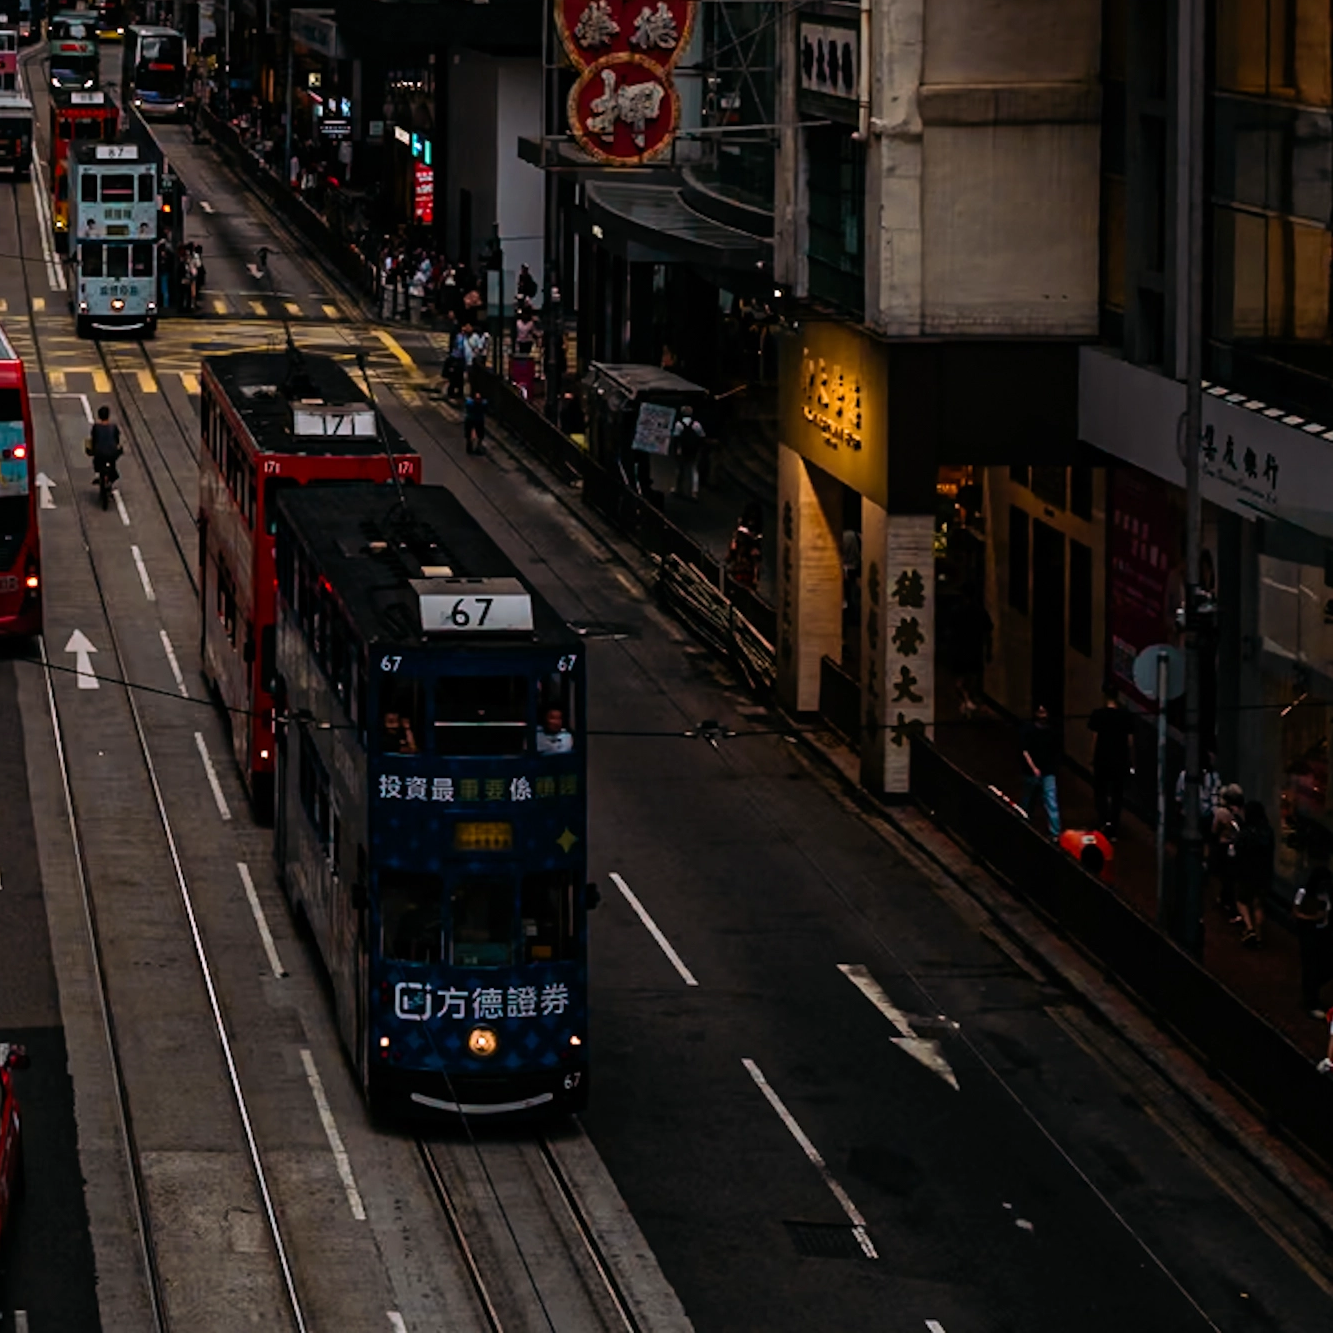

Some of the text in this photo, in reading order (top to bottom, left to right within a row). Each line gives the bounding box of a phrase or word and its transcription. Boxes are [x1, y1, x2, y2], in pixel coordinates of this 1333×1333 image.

[585, 69, 665, 149] 押
[264, 460, 280, 474] 171
[398, 461, 413, 474] 171
[451, 598, 493, 626] 67
[380, 654, 402, 673] 67
[556, 654, 578, 672] 67
[436, 982, 570, 1020] 方德證券
[563, 1071, 581, 1090] 67
